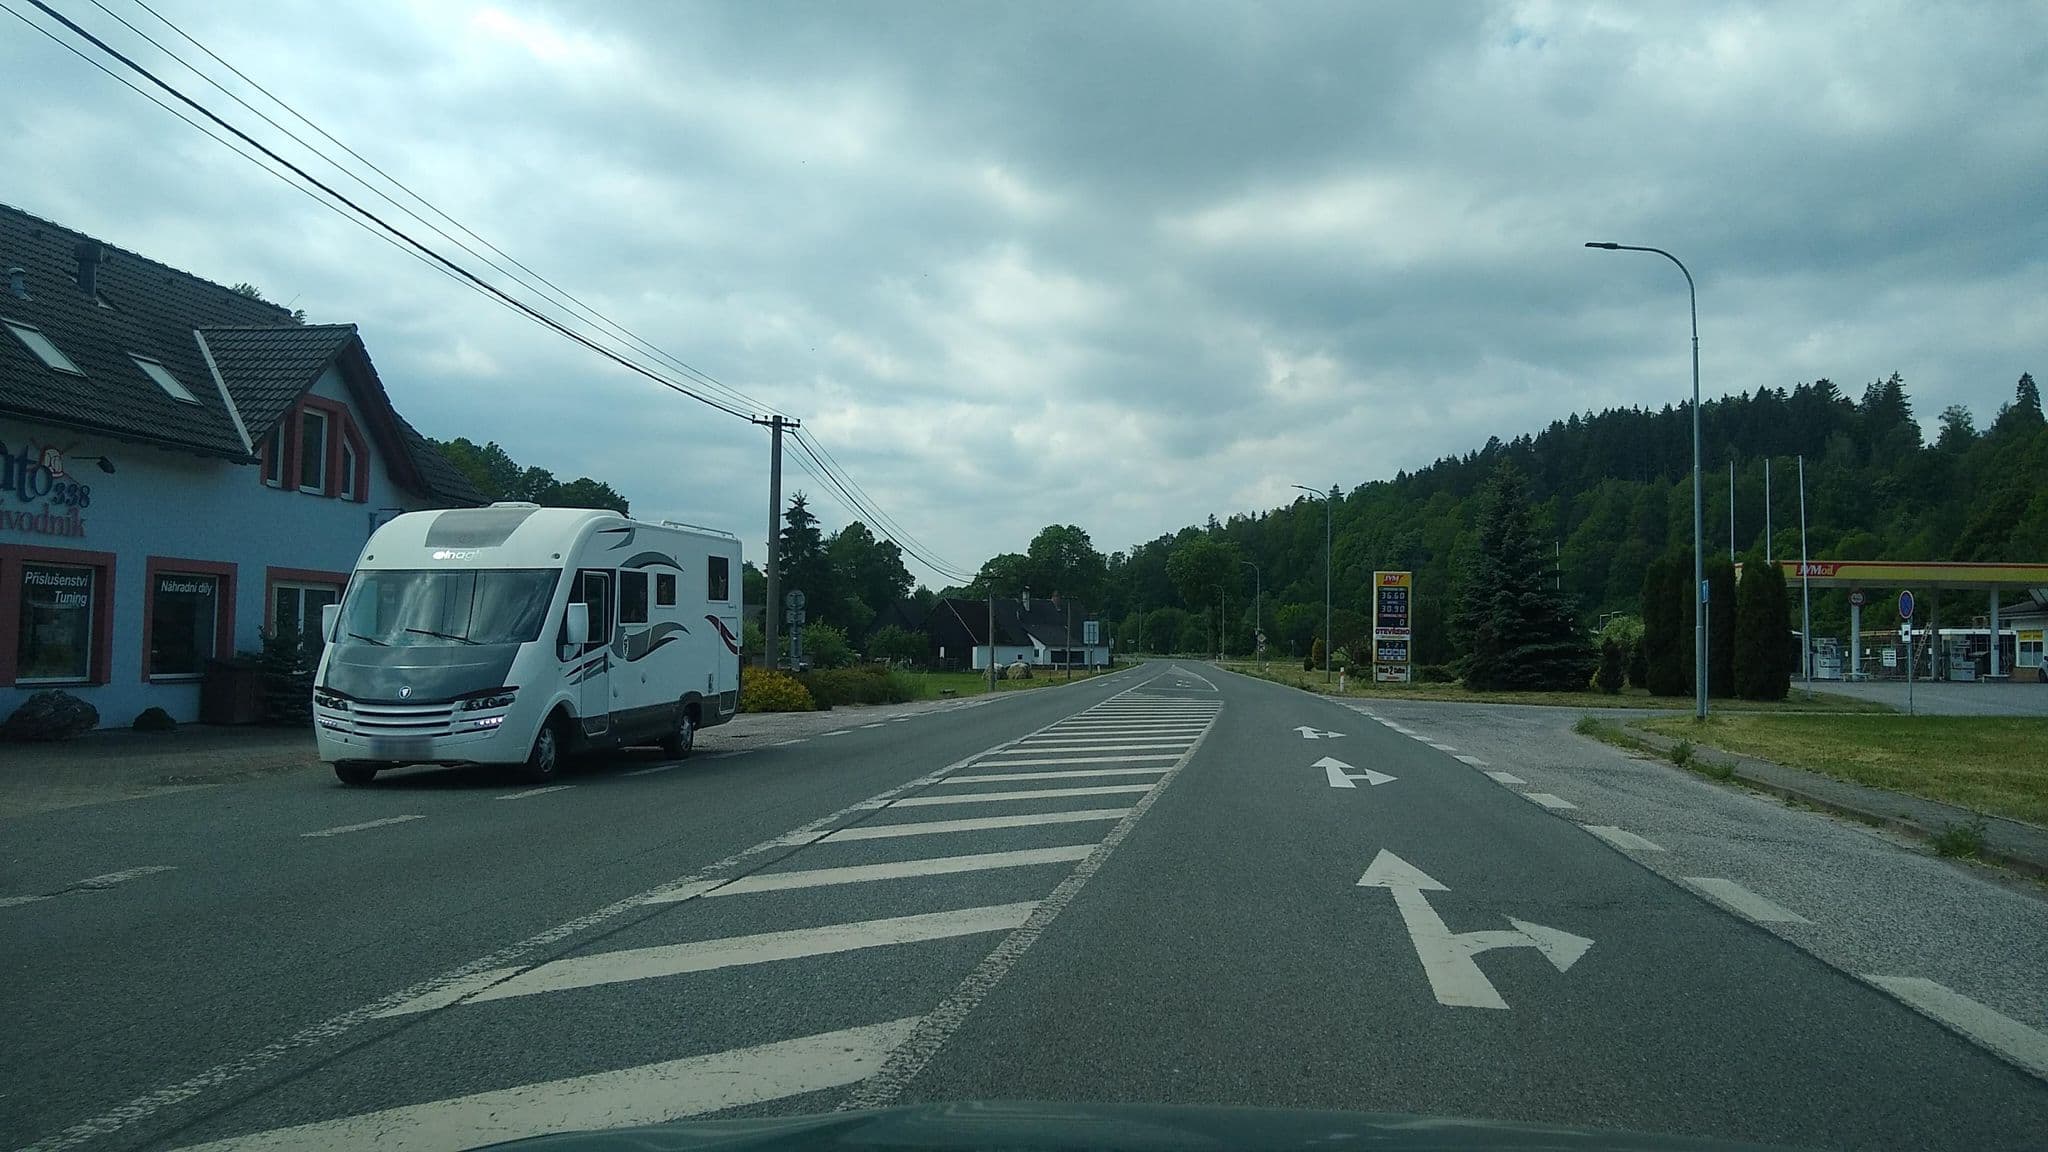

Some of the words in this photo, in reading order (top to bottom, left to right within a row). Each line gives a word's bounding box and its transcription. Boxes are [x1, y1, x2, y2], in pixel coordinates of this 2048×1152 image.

[161, 580, 197, 593] Náhradní
[198, 582, 213, 596] díly
[55, 590, 88, 607] Tuning
